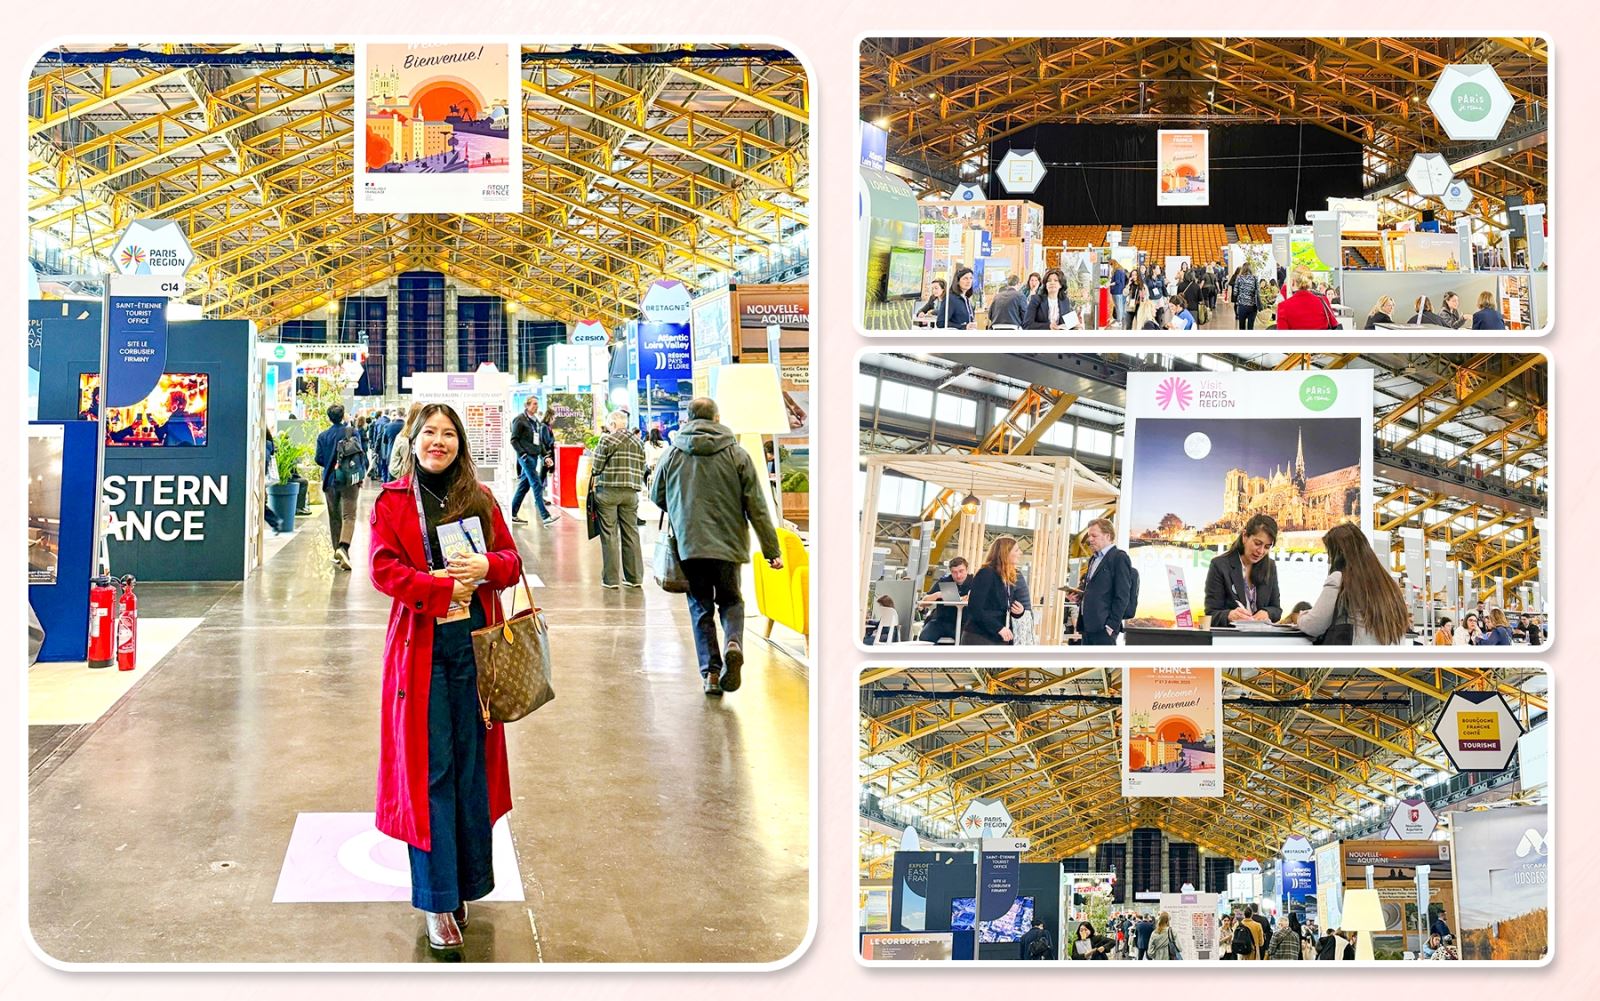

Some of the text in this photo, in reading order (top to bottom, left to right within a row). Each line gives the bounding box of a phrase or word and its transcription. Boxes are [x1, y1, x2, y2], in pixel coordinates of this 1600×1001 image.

[403, 46, 484, 69] Bienvenue!
[149, 249, 177, 258] PARIS
[149, 258, 185, 266] REGION
[160, 283, 179, 292] C14
[746, 304, 804, 314] NOUVELLE-
[658, 334, 689, 342] Atlantic
[665, 342, 689, 350] Valley
[1200, 380, 1222, 390] Visit
[1200, 390, 1228, 398] PARIS
[1200, 400, 1236, 408] REGION
[1152, 687, 1198, 700] Welcome!
[1152, 697, 1200, 710] Bienvenue!
